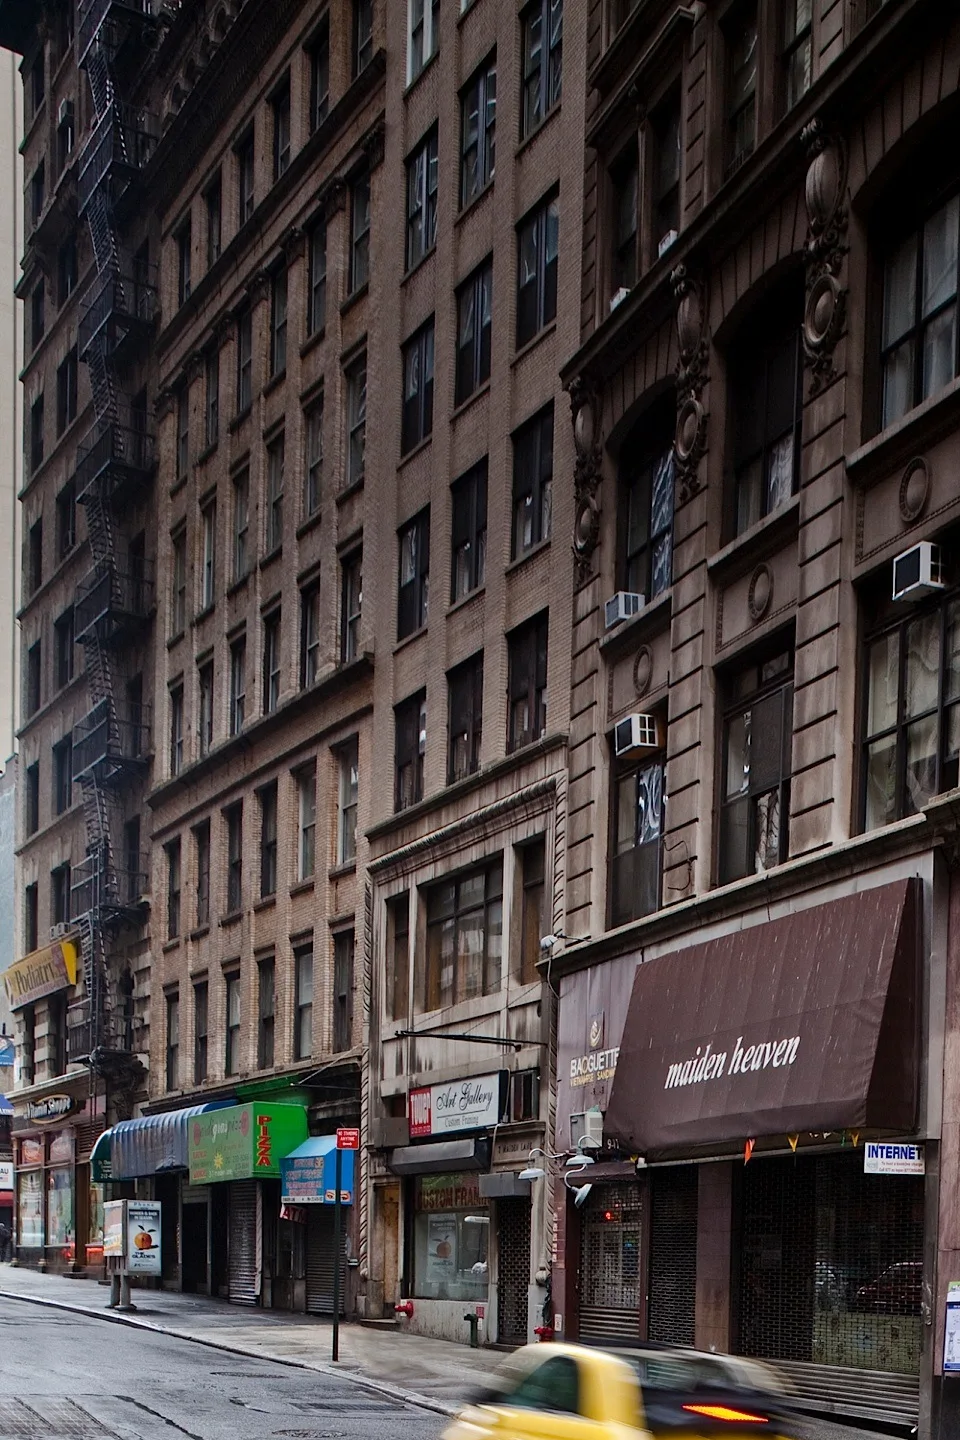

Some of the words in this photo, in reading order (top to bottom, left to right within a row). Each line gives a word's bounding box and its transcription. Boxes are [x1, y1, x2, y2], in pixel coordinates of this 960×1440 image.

[664, 1043, 727, 1089] maiden
[727, 1036, 800, 1076] heaven
[436, 1087, 457, 1110] Art
[458, 1082, 494, 1111] Gallery
[256, 1115, 272, 1167] PIZZA
[867, 1144, 923, 1160] INTERNET
